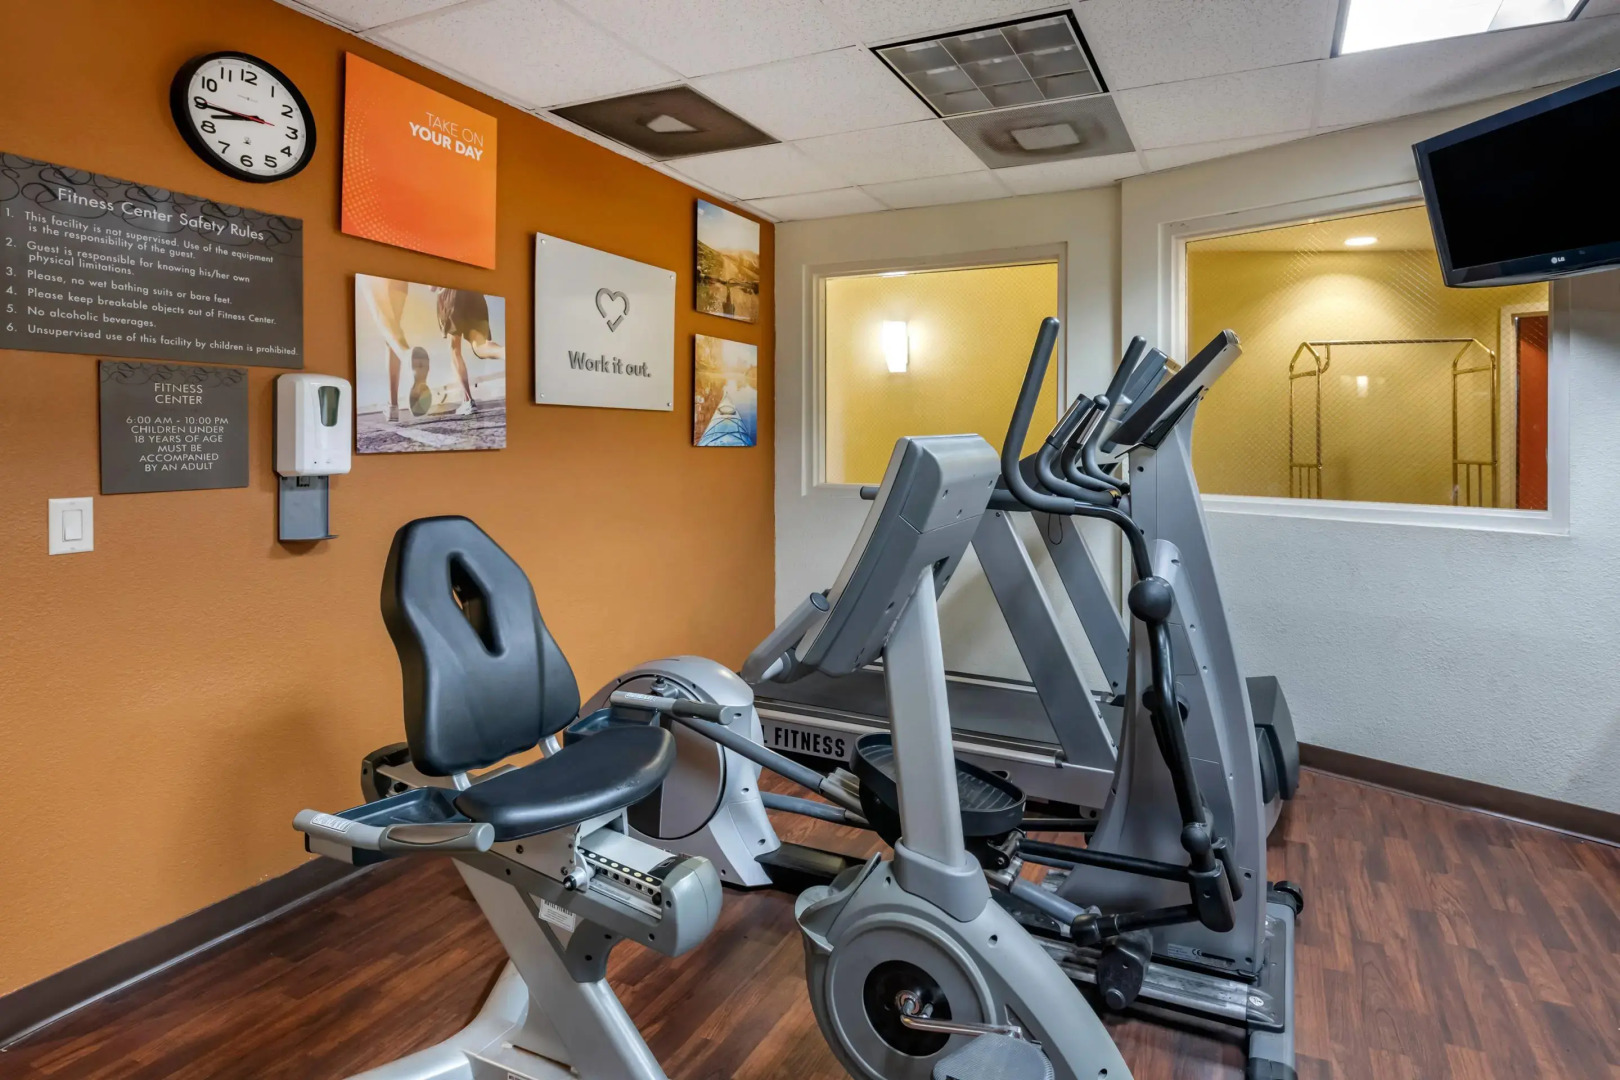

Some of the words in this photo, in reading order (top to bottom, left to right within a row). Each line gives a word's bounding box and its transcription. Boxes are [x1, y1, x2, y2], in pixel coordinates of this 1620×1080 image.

[221, 66, 232, 82] 11
[241, 68, 257, 86] 12
[201, 76, 218, 93] 10
[193, 96, 208, 110] 9
[281, 104, 294, 118] 2
[200, 120, 216, 134] 8
[285, 126, 298, 140] 3
[425, 111, 458, 138] TAKE
[462, 128, 484, 147] ON
[218, 140, 230, 154] 7
[409, 121, 452, 150] YOUR
[455, 140, 483, 162] DAY
[280, 146, 292, 158] 4
[240, 155, 253, 168] 6
[264, 155, 278, 168] 5
[58, 188, 114, 211] Fitness
[121, 202, 173, 222] Center
[180, 213, 225, 235] Safety
[230, 223, 264, 241] Rules
[25, 211, 47, 223] This
[51, 215, 88, 232] facility
[93, 224, 101, 233] is
[106, 228, 122, 237] not
[126, 231, 180, 247] supervised.
[183, 240, 200, 251] Use
[203, 244, 212, 253] of
[215, 246, 229, 256] the
[231, 251, 274, 263] equipment
[28, 223, 37, 232] is
[42, 225, 59, 236] the
[64, 231, 133, 250] responsibility
[137, 242, 147, 250] of
[151, 243, 166, 254] the
[169, 249, 196, 259] guest.
[26, 241, 59, 254] Guest
[64, 246, 73, 256] is
[77, 250, 135, 266] responsible
[139, 257, 153, 268] for
[157, 261, 195, 276] knowing
[199, 267, 230, 280] his/her
[232, 275, 250, 283] own
[28, 252, 74, 266] physical
[79, 258, 135, 275] limitations.
[27, 269, 66, 284] Please,
[89, 280, 107, 288] wet
[111, 280, 149, 295] bathing
[153, 287, 173, 297] suits
[190, 291, 211, 302] bare
[214, 294, 232, 305] feet.
[27, 287, 63, 300] Please
[68, 291, 93, 305] keep
[97, 295, 148, 310] breakable
[151, 303, 185, 315] objects
[188, 309, 202, 317] out
[205, 309, 215, 317] of
[217, 310, 245, 321] Fitness
[248, 314, 277, 325] Center.
[27, 306, 45, 316] No
[49, 308, 99, 322] alcoholic
[102, 313, 156, 329] beverages.
[27, 324, 101, 339] Unsupervised
[105, 333, 123, 341] use
[126, 333, 137, 342] of
[140, 334, 157, 344] this
[160, 335, 192, 349] facility
[195, 338, 206, 349] by
[209, 341, 244, 351] children
[246, 344, 253, 352] is
[256, 345, 299, 356] prohibited.
[568, 350, 610, 373] Work
[612, 357, 623, 375] it
[625, 362, 652, 378] out.
[154, 382, 203, 394] FITNESS
[155, 394, 203, 405] CENTER
[126, 415, 151, 424] 6:00
[154, 416, 173, 424] AM
[185, 416, 211, 424] 10:00
[130, 425, 186, 434] CHILDREN
[189, 425, 224, 434] UNDER
[135, 435, 145, 443] 18
[149, 435, 181, 443] YEARS
[185, 435, 200, 443] OF
[202, 434, 224, 443] AGE
[157, 444, 187, 453] MUST
[190, 444, 202, 452] BE
[139, 453, 219, 463] ACCOMPANIED
[144, 464, 157, 472] BY
[161, 463, 177, 471] AN
[180, 462, 213, 471] ADULT
[775, 727, 845, 757] FITNESS
